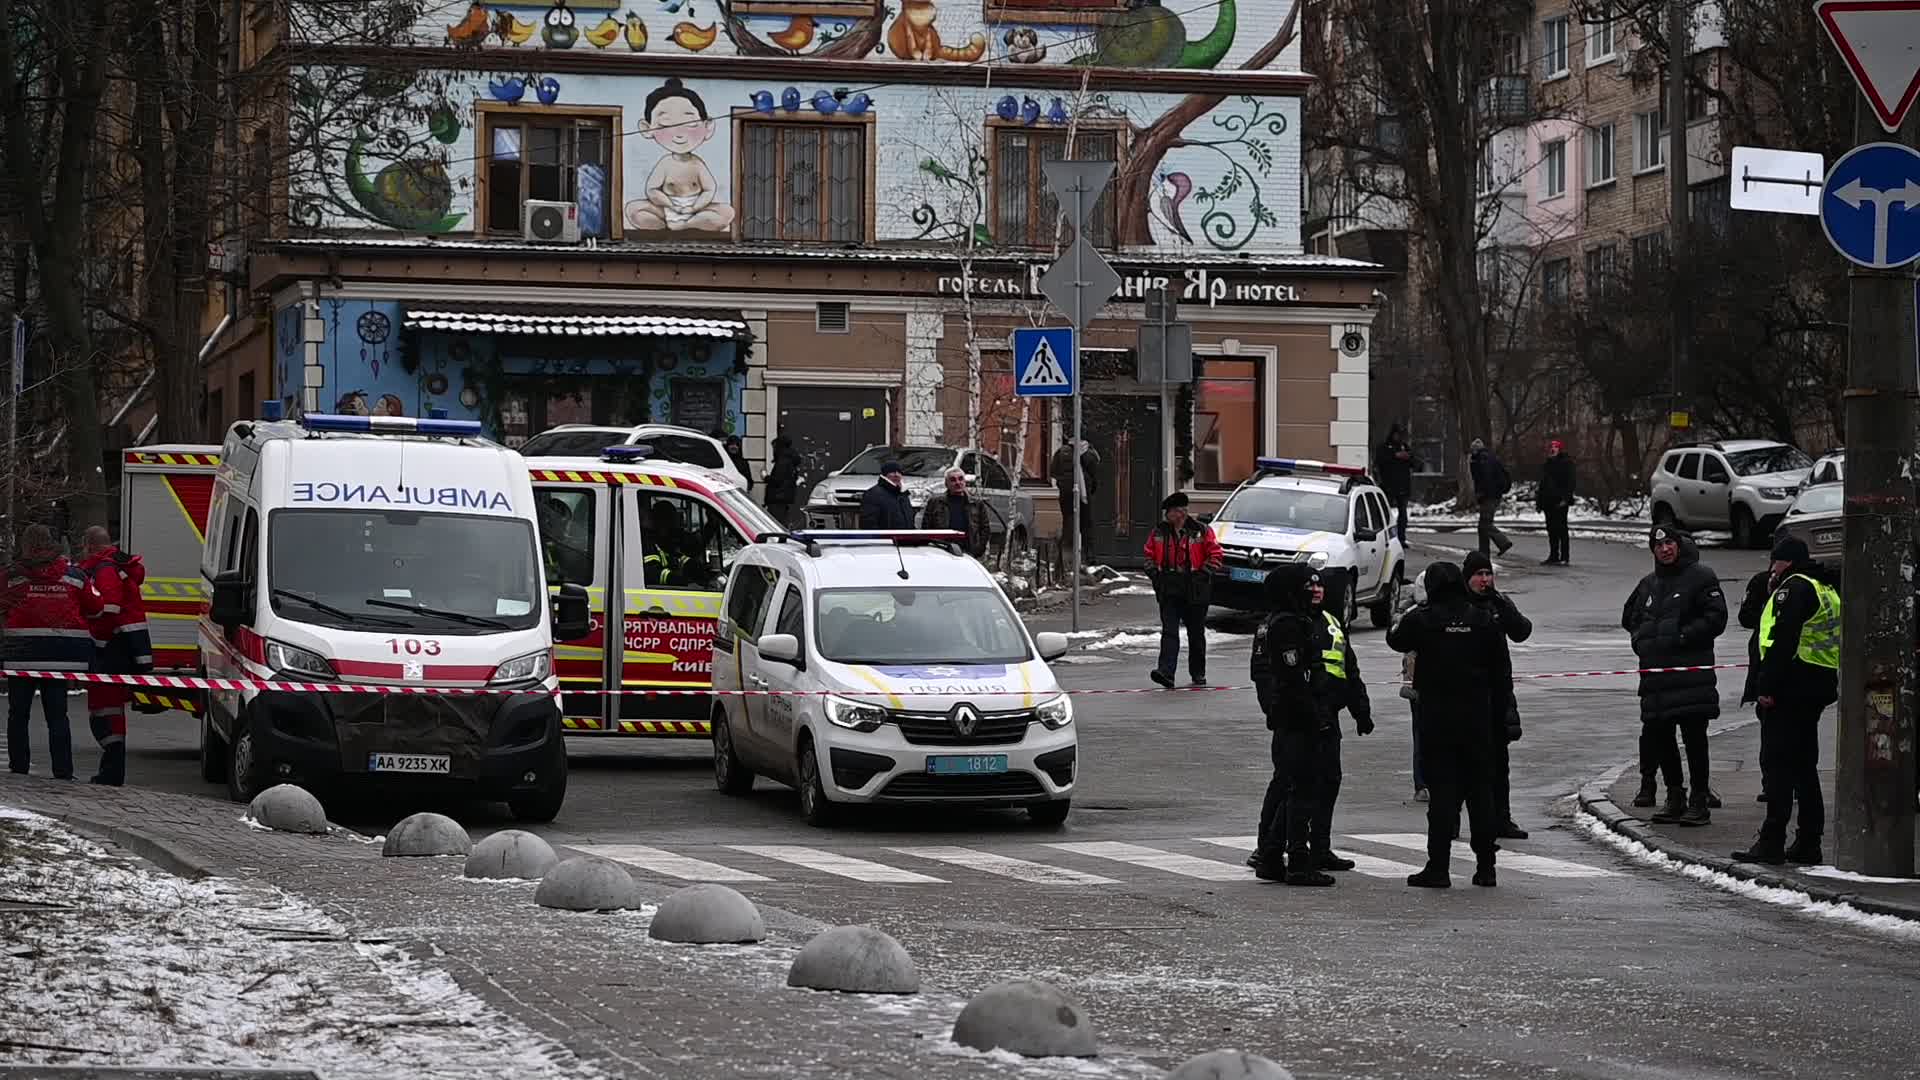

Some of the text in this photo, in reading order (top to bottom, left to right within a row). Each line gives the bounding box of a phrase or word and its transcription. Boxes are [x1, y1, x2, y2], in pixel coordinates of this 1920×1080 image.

[1182, 269, 1226, 308] Яр
[1235, 284, 1300, 301] HOTEL
[385, 638, 441, 656] 103
[377, 756, 449, 771] AA 9235 XK
[967, 756, 997, 771] 1812
